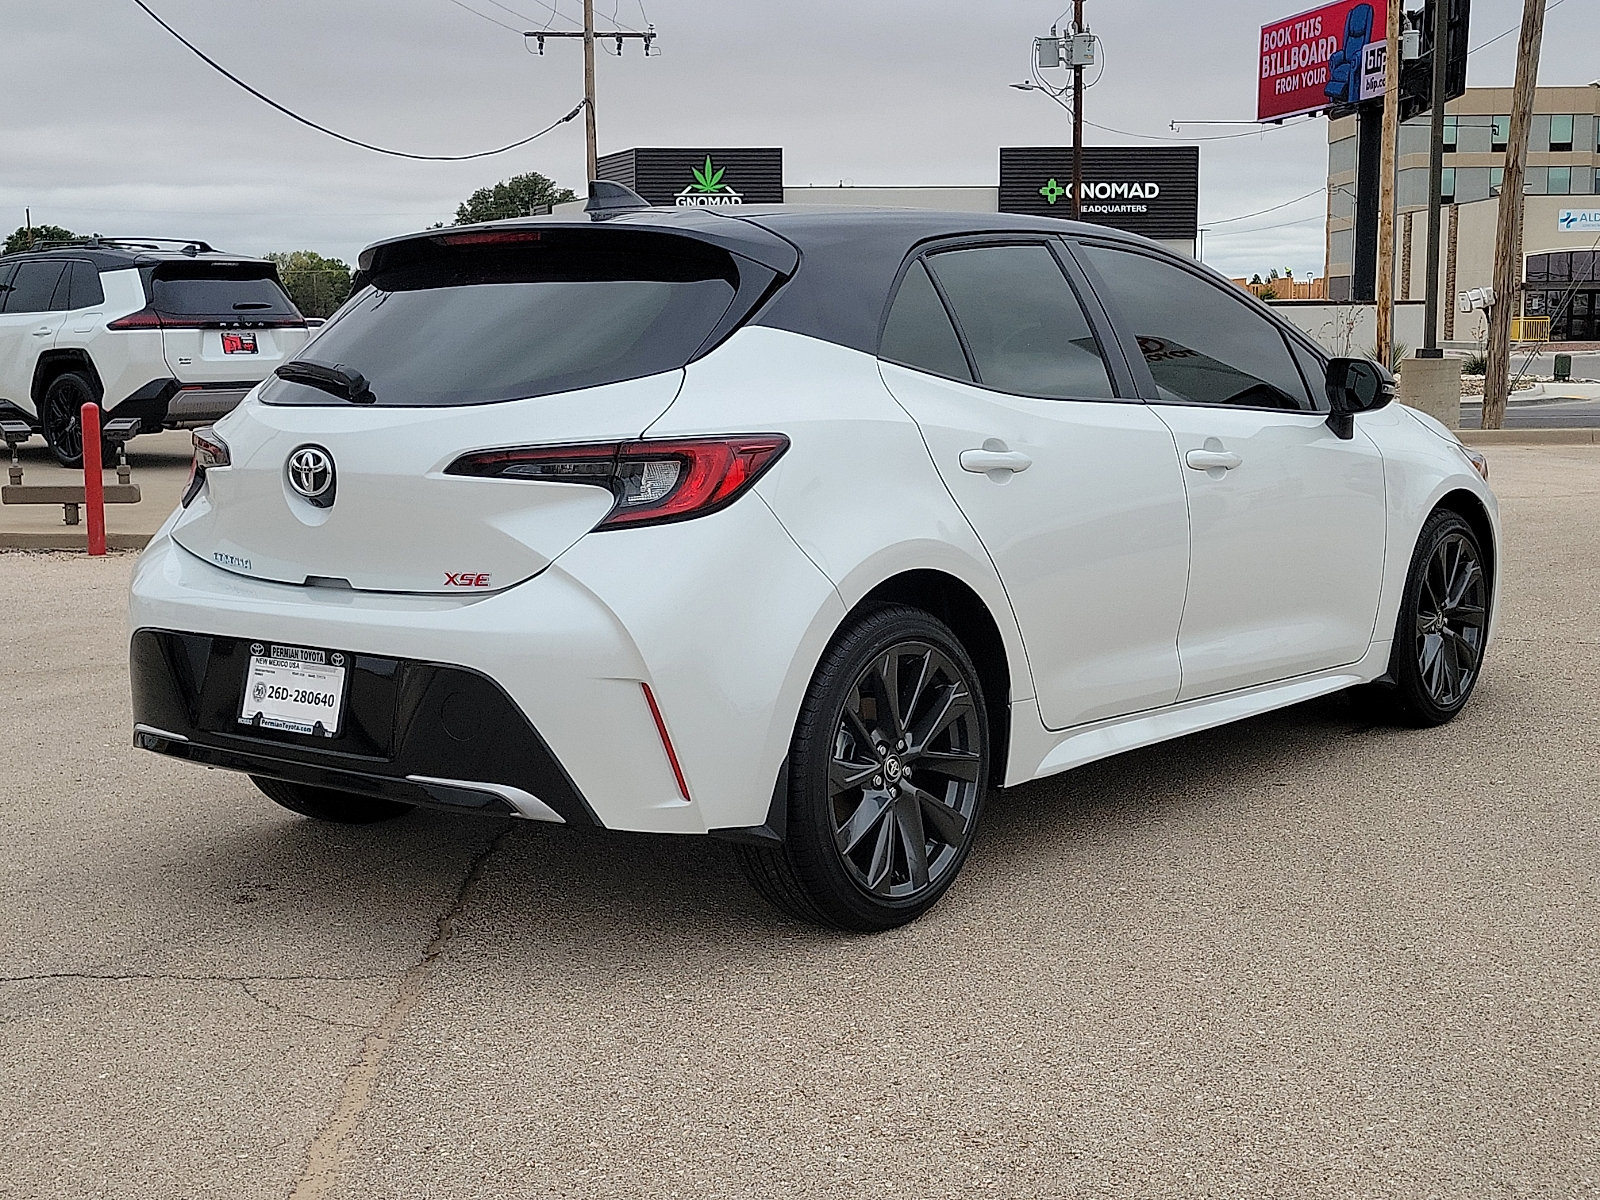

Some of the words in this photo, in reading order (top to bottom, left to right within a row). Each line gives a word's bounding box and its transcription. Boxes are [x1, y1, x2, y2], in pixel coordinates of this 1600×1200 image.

[1263, 26, 1293, 52] BOOK
[1295, 15, 1323, 41] THIS
[1262, 36, 1338, 79] BILLBOARD
[1275, 73, 1300, 95] FROM
[1301, 67, 1327, 89] YOUR
[676, 196, 742, 207] GNOMAD
[444, 572, 491, 587] XSE
[272, 646, 299, 660] PERMIAN
[300, 649, 324, 663] TOYOTA
[268, 660, 288, 668] MEXICO
[267, 685, 335, 708] 26D-280640
[261, 719, 312, 733] PermianToyota.com
